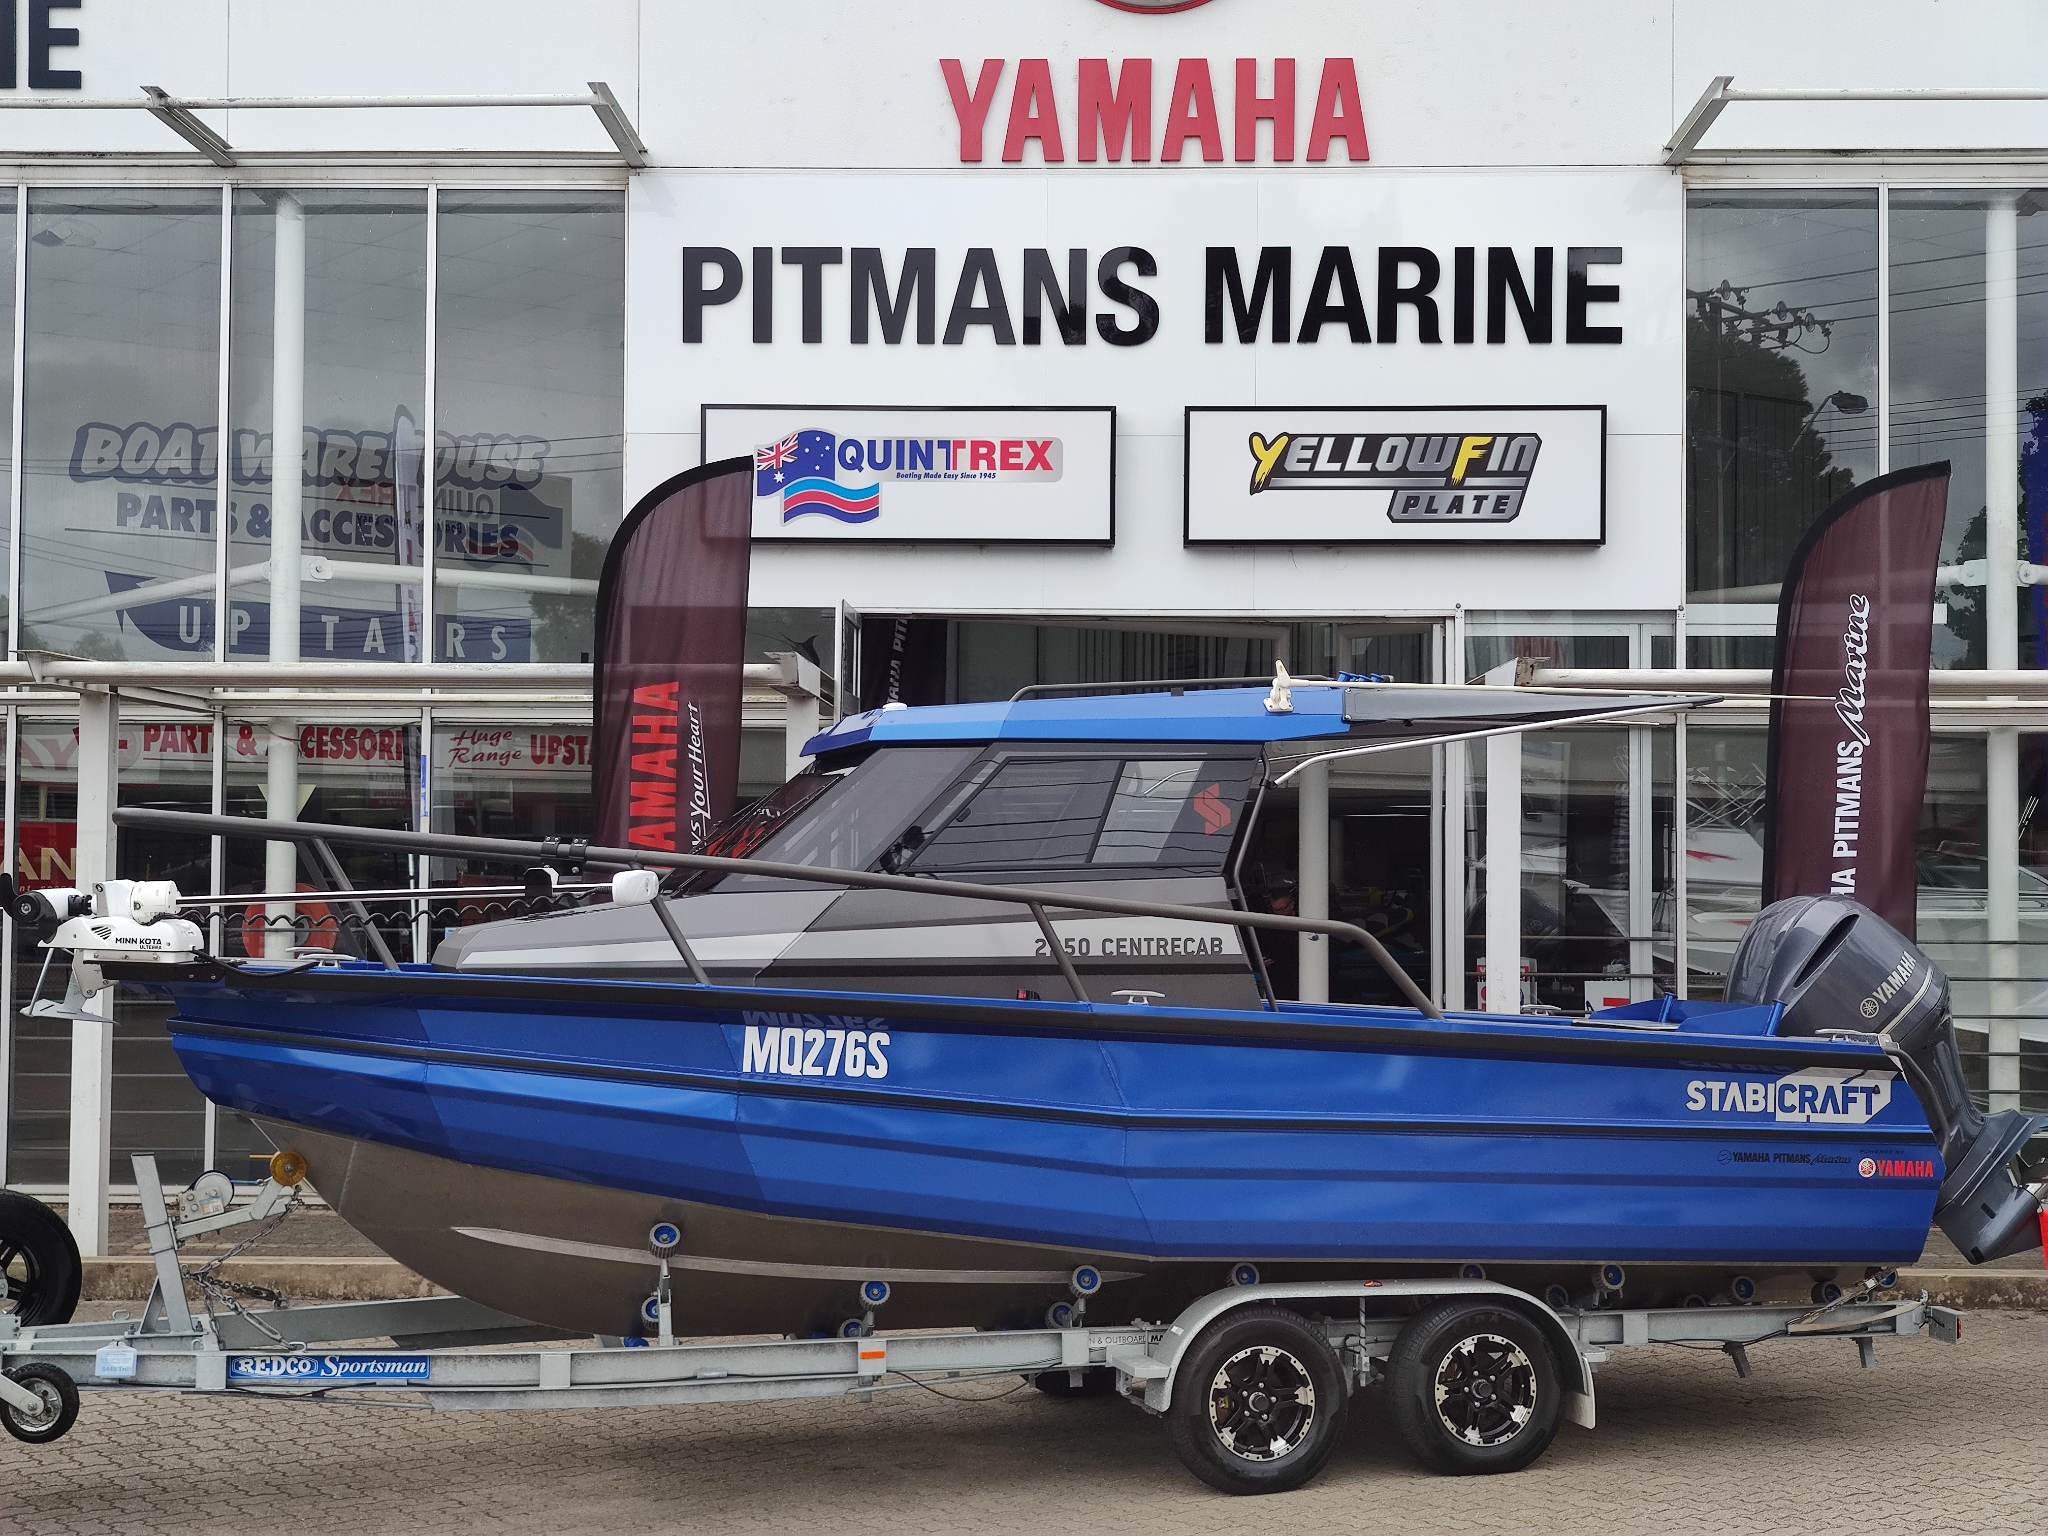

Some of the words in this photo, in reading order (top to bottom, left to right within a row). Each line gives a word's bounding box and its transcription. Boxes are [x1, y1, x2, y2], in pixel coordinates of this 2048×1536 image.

[939, 58, 1370, 162] YAMAHA
[682, 246, 1160, 346] PITMANS
[1204, 246, 1623, 346] MARINE
[73, 423, 220, 482] BOAT
[238, 427, 549, 489] WAREOUSE
[838, 439, 1054, 473] QUINTREX
[1250, 433, 1541, 491] YELLOWFIN
[896, 472, 922, 480] Boating
[943, 472, 959, 480] Easy
[1401, 495, 1512, 514] PLATE
[1834, 594, 1872, 746] Marine
[144, 725, 213, 753] PART
[237, 725, 258, 756] &
[452, 729, 513, 746] Huge
[448, 748, 522, 768] Range
[628, 681, 680, 853] AMAHA
[1832, 740, 1865, 857] PITMANS
[115, 937, 137, 945] MINN
[139, 937, 162, 945] KOTA
[1034, 937, 1091, 957] 250
[1101, 936, 1224, 956] CENTRECAB
[1872, 950, 1917, 1005] YAMAHA
[742, 1025, 891, 1079] MQ276S
[1685, 1080, 1876, 1116] STABICRAFT
[1732, 1151, 1770, 1164] YAMAHA
[1773, 1152, 1811, 1164] PITMANS
[1877, 1159, 1934, 1178] YAMAHA
[237, 1356, 313, 1376] REDCO
[320, 1354, 427, 1378] Sportsman
